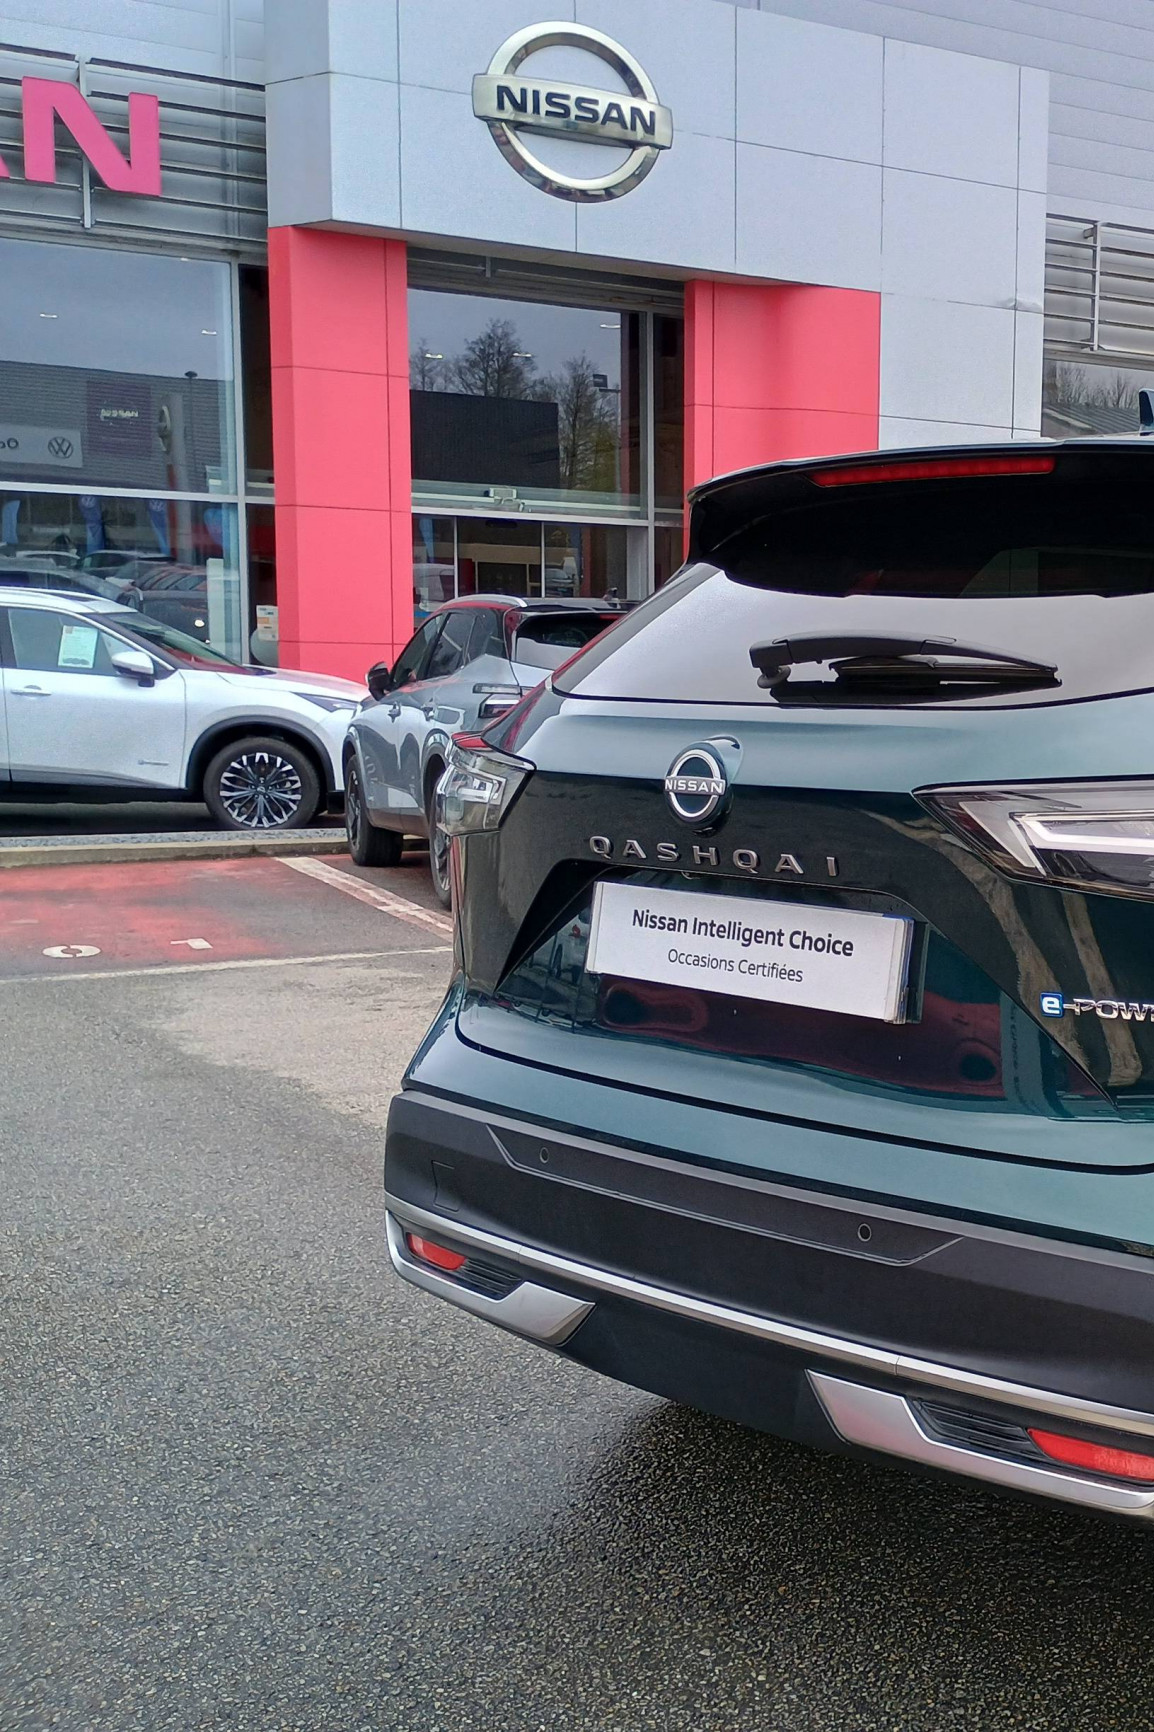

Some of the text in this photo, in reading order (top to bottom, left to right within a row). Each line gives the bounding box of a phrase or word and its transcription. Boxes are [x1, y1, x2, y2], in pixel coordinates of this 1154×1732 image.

[496, 84, 656, 136] NISSAN
[0, 76, 162, 196] N
[664, 778, 724, 794] NISSAN
[589, 835, 839, 877] QASHQAI
[632, 908, 855, 957] Nissan Intelligent Choice
[667, 948, 804, 983] Occasions Certifiées
